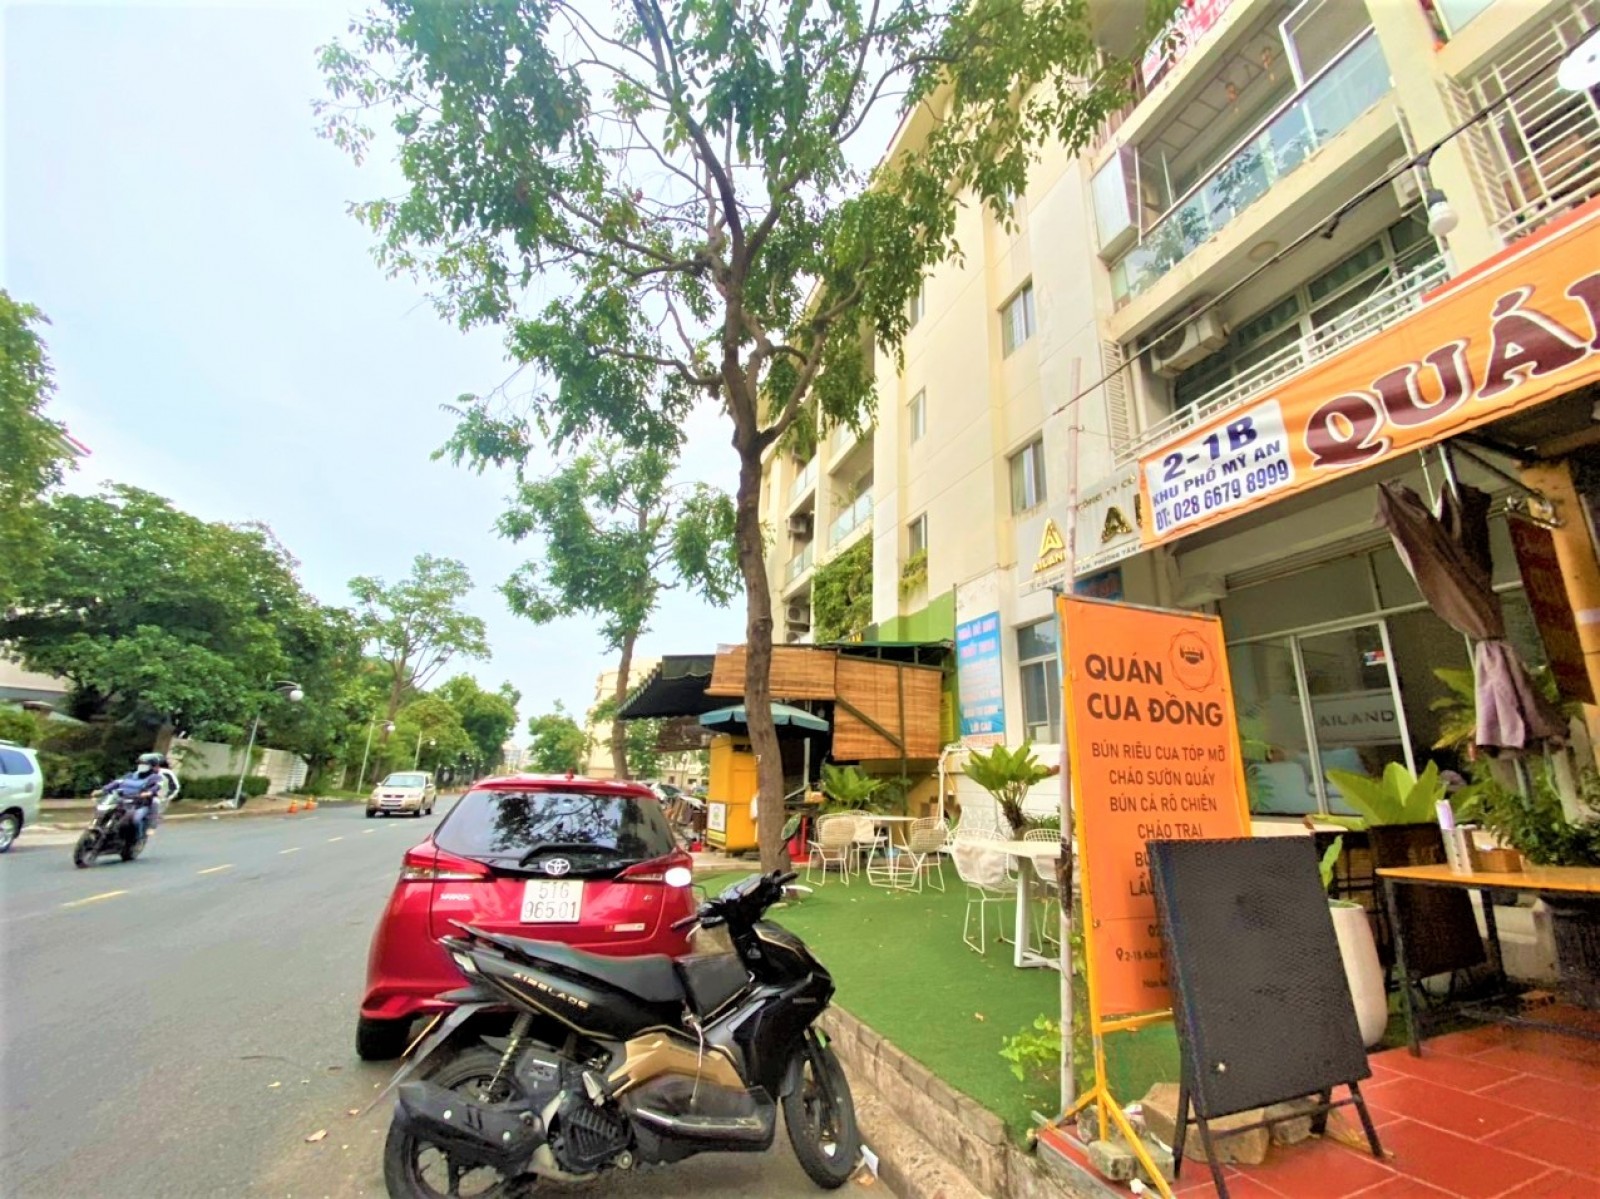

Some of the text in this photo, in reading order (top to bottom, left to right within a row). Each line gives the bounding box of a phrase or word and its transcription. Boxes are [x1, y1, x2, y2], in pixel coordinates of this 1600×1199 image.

[1163, 416, 1257, 482] 2-1B
[1153, 485, 1179, 507] KHU
[1184, 464, 1216, 492] PHỐ
[1254, 440, 1280, 462] AN
[1174, 495, 1200, 521] 028
[1204, 478, 1241, 509] 6679
[1246, 459, 1290, 493] 8999
[1085, 652, 1163, 685] QUÁN
[1087, 691, 1223, 727] CUA ĐỒNG
[1320, 710, 1395, 727] AILAND
[1091, 739, 1119, 759] BÚN
[1123, 741, 1151, 759] RIÊU
[1155, 746, 1180, 761] CUA
[1182, 744, 1204, 761] TÓP
[1109, 766, 1143, 785] CHÁO
[1147, 768, 1181, 785] SƯỜN
[1110, 793, 1136, 812] BÚN
[1140, 793, 1157, 812] CÁ
[1181, 794, 1217, 812] CHIÊN
[1137, 819, 1203, 839] CHÁO TRAI
[538, 881, 569, 898] 51G
